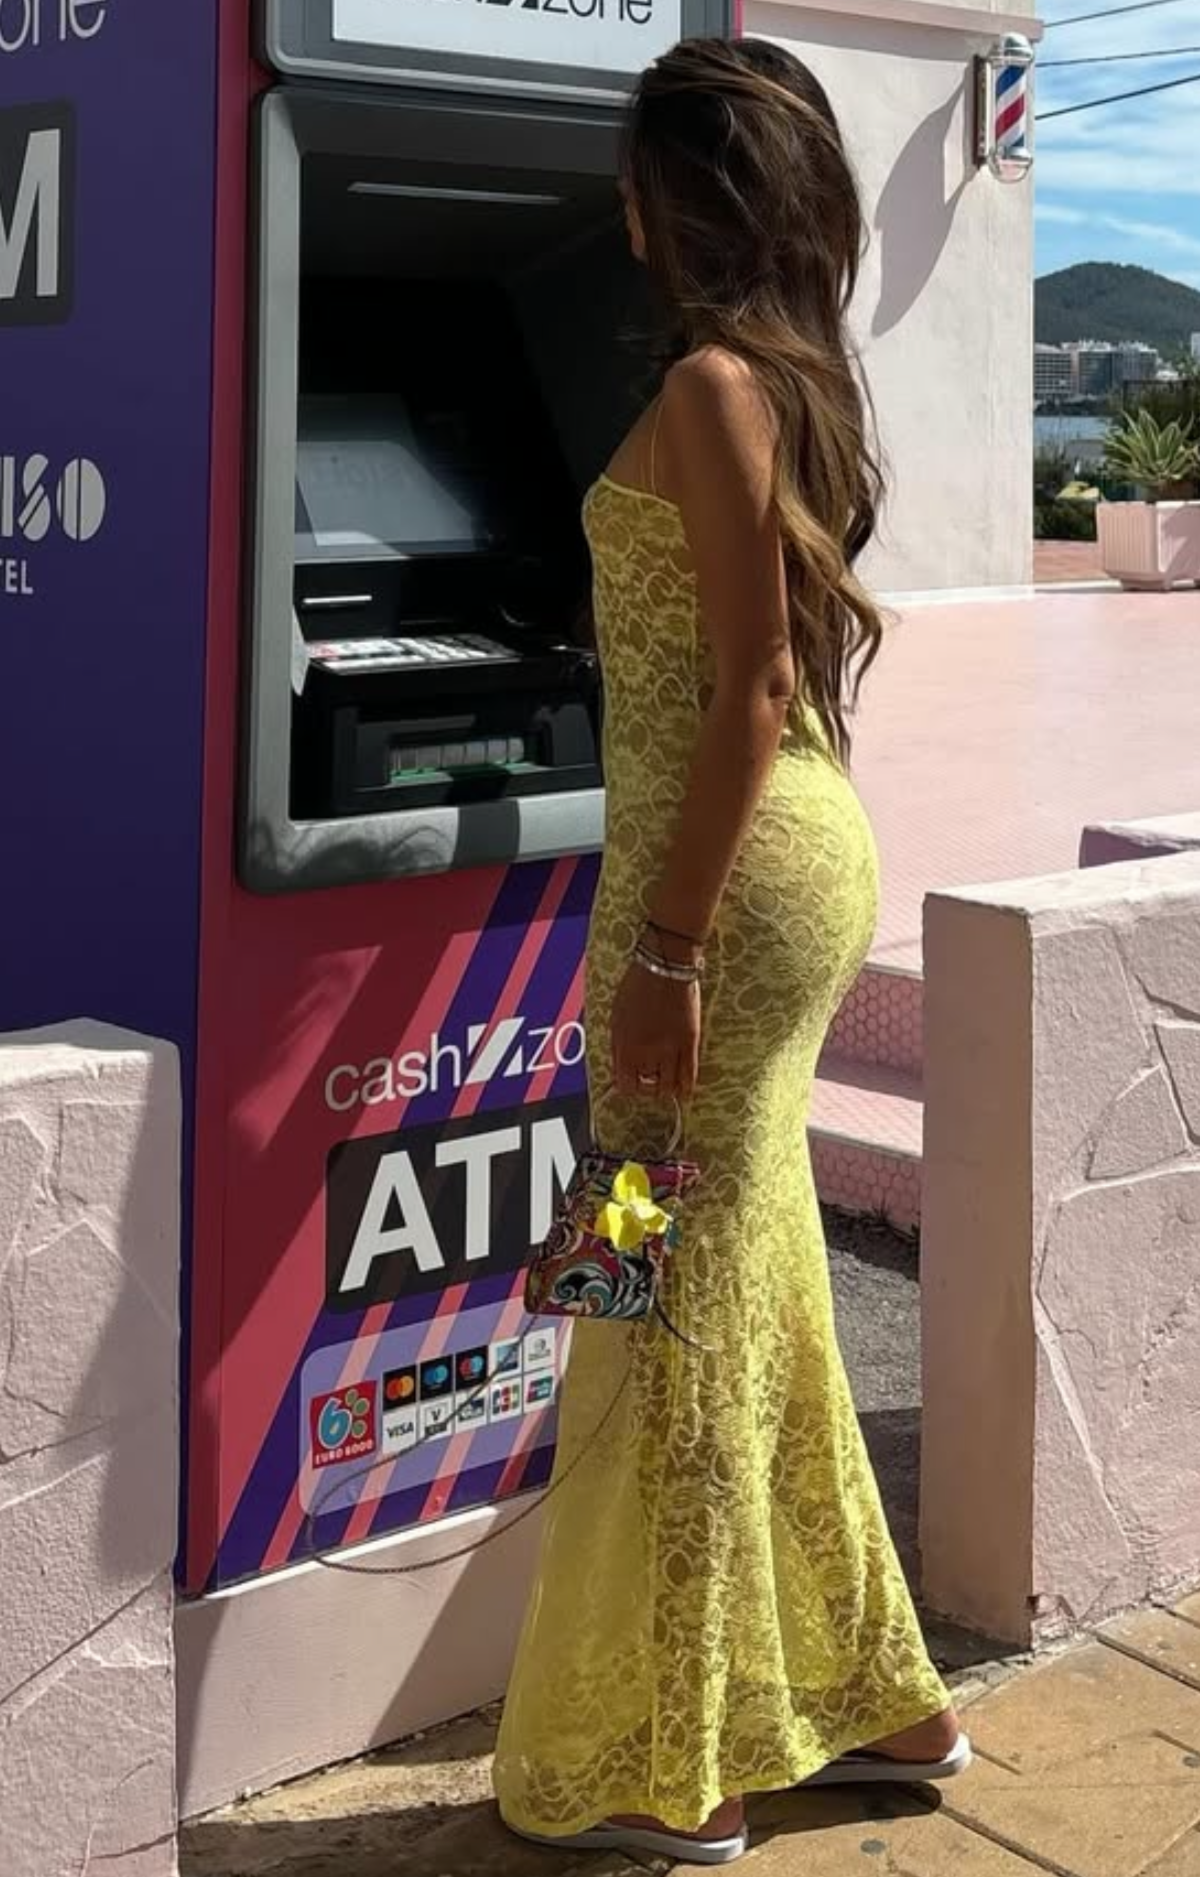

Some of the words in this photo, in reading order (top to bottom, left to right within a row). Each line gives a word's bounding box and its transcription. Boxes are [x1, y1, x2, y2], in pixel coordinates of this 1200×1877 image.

[0, 558, 34, 595] EL
[325, 1032, 461, 1111] cash
[387, 1421, 414, 1440] VISA
